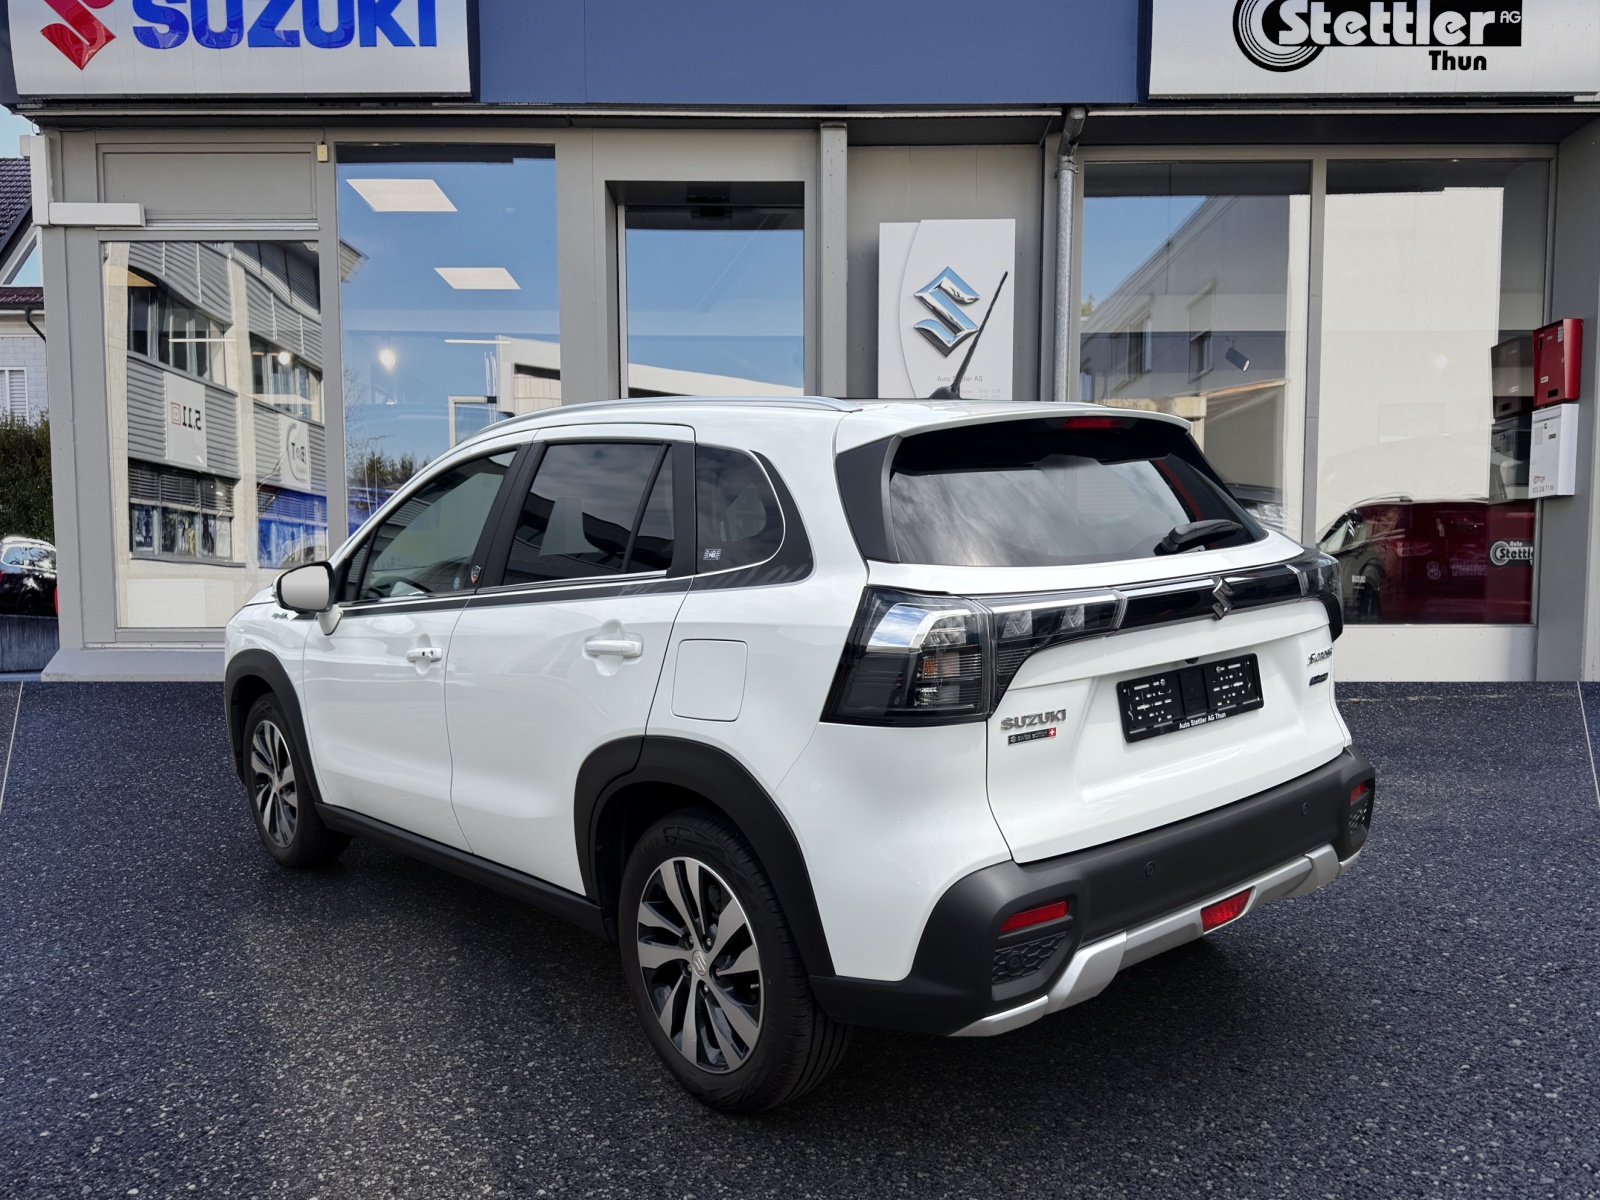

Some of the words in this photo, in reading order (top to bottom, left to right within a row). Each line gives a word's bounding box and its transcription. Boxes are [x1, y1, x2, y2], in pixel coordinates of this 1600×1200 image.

[132, 0, 437, 49] SUZUKI
[1278, 0, 1495, 46] Stettler
[1500, 11, 1521, 24] AG
[1428, 50, 1487, 71] Thun
[1000, 708, 1066, 731] SUZUKI
[1178, 722, 1190, 730] Auto
[1190, 717, 1207, 726] Stettler
[1207, 714, 1215, 722] AG
[1215, 712, 1226, 720] Thun
